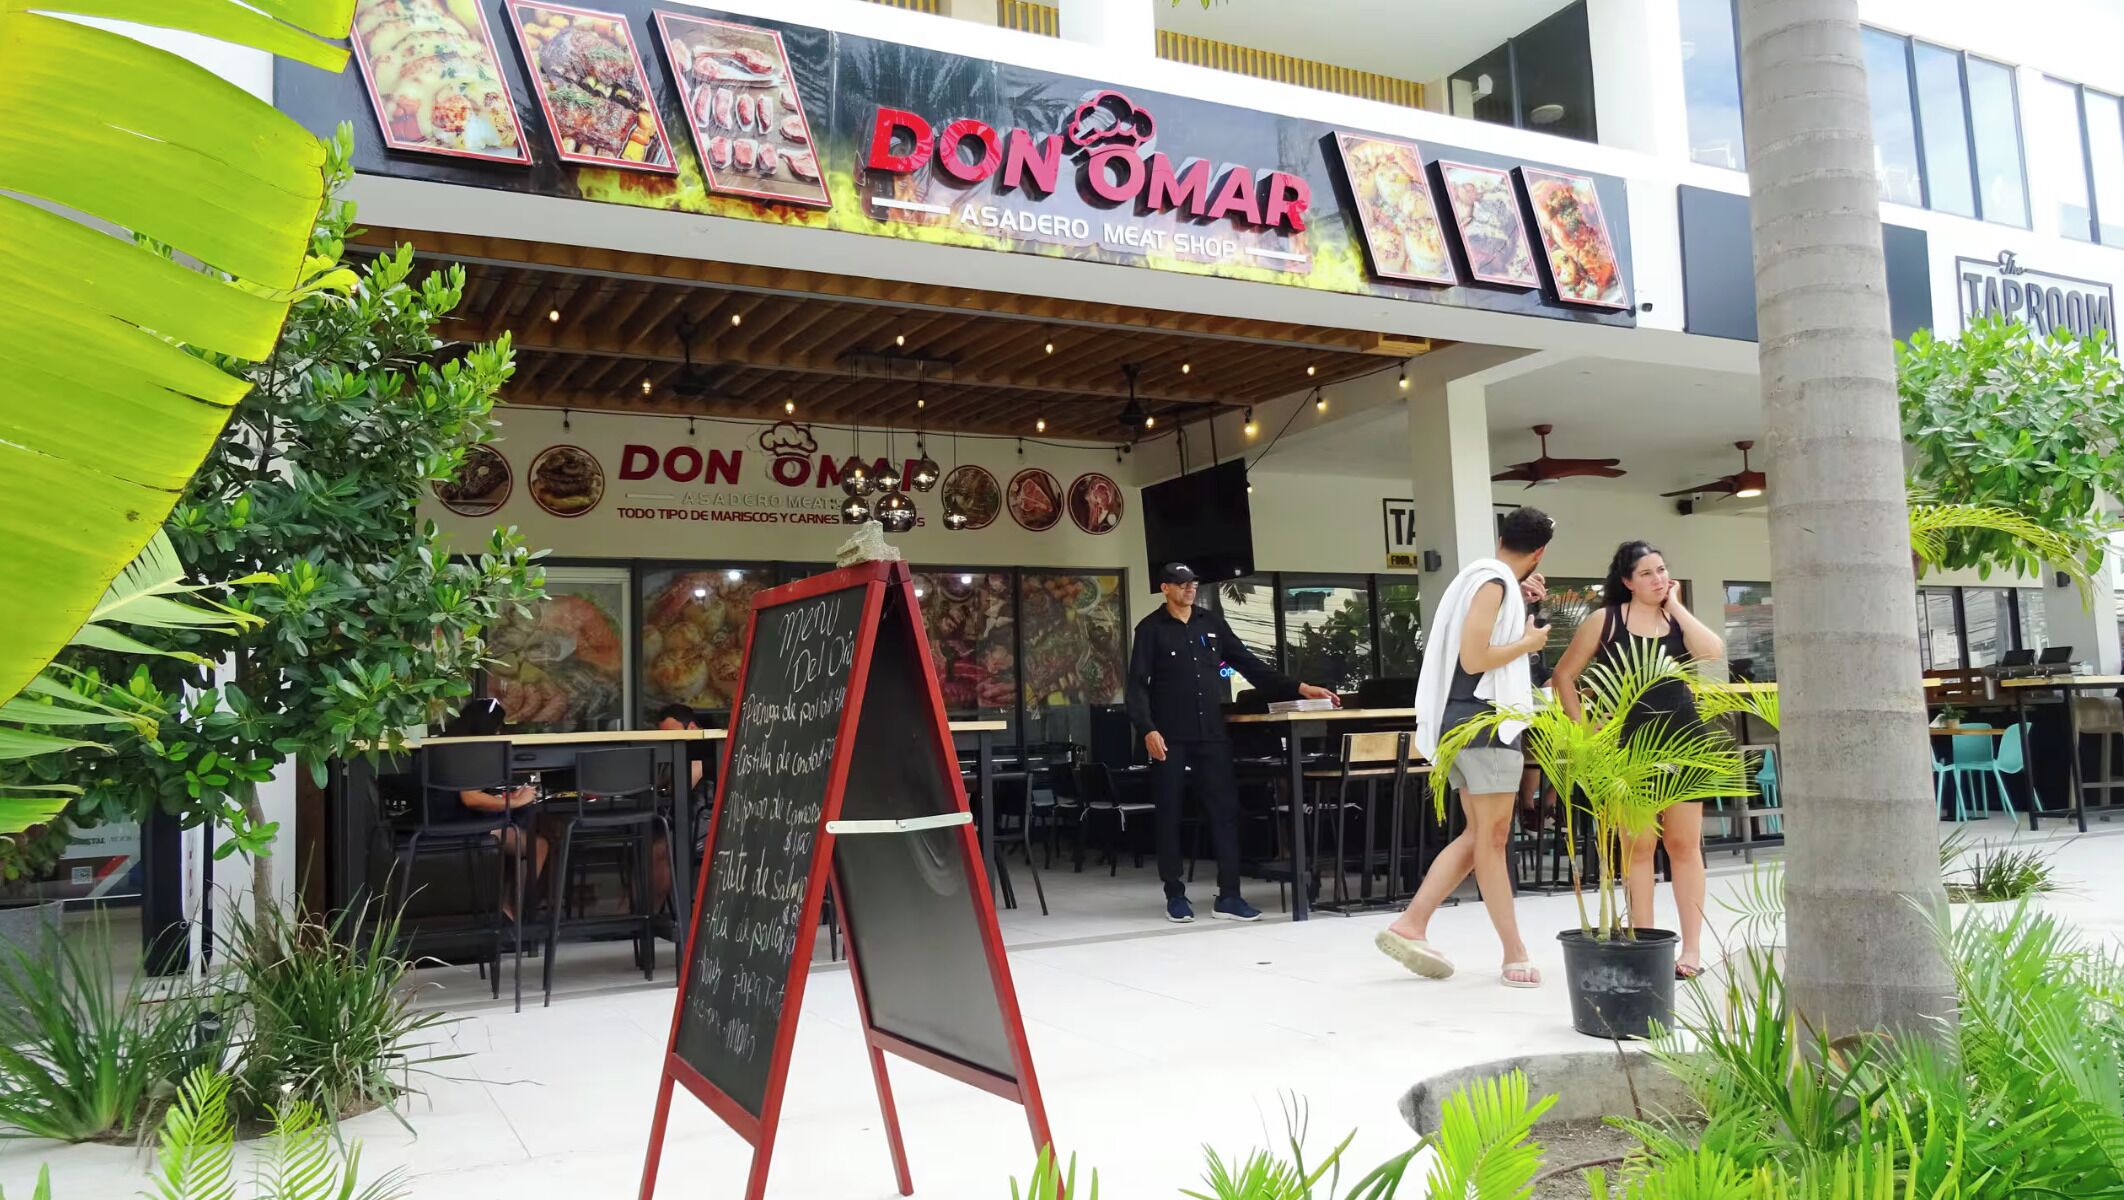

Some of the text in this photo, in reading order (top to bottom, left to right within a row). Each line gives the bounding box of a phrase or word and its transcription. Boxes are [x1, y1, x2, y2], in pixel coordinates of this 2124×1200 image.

[866, 106, 1312, 232] DON OMAR
[959, 206, 1238, 258] ASADERO MEAT SHOP
[1997, 249, 2025, 276] The
[1962, 272, 2111, 347] TAPROOM
[618, 444, 743, 485] DON
[617, 507, 655, 520] TODO
[657, 508, 689, 521] TIPO
[691, 510, 709, 522] DE
[711, 510, 778, 523] MARISCOS
[780, 512, 790, 523] Y
[790, 512, 840, 525] CARNES
[681, 491, 781, 509] ASADERO
